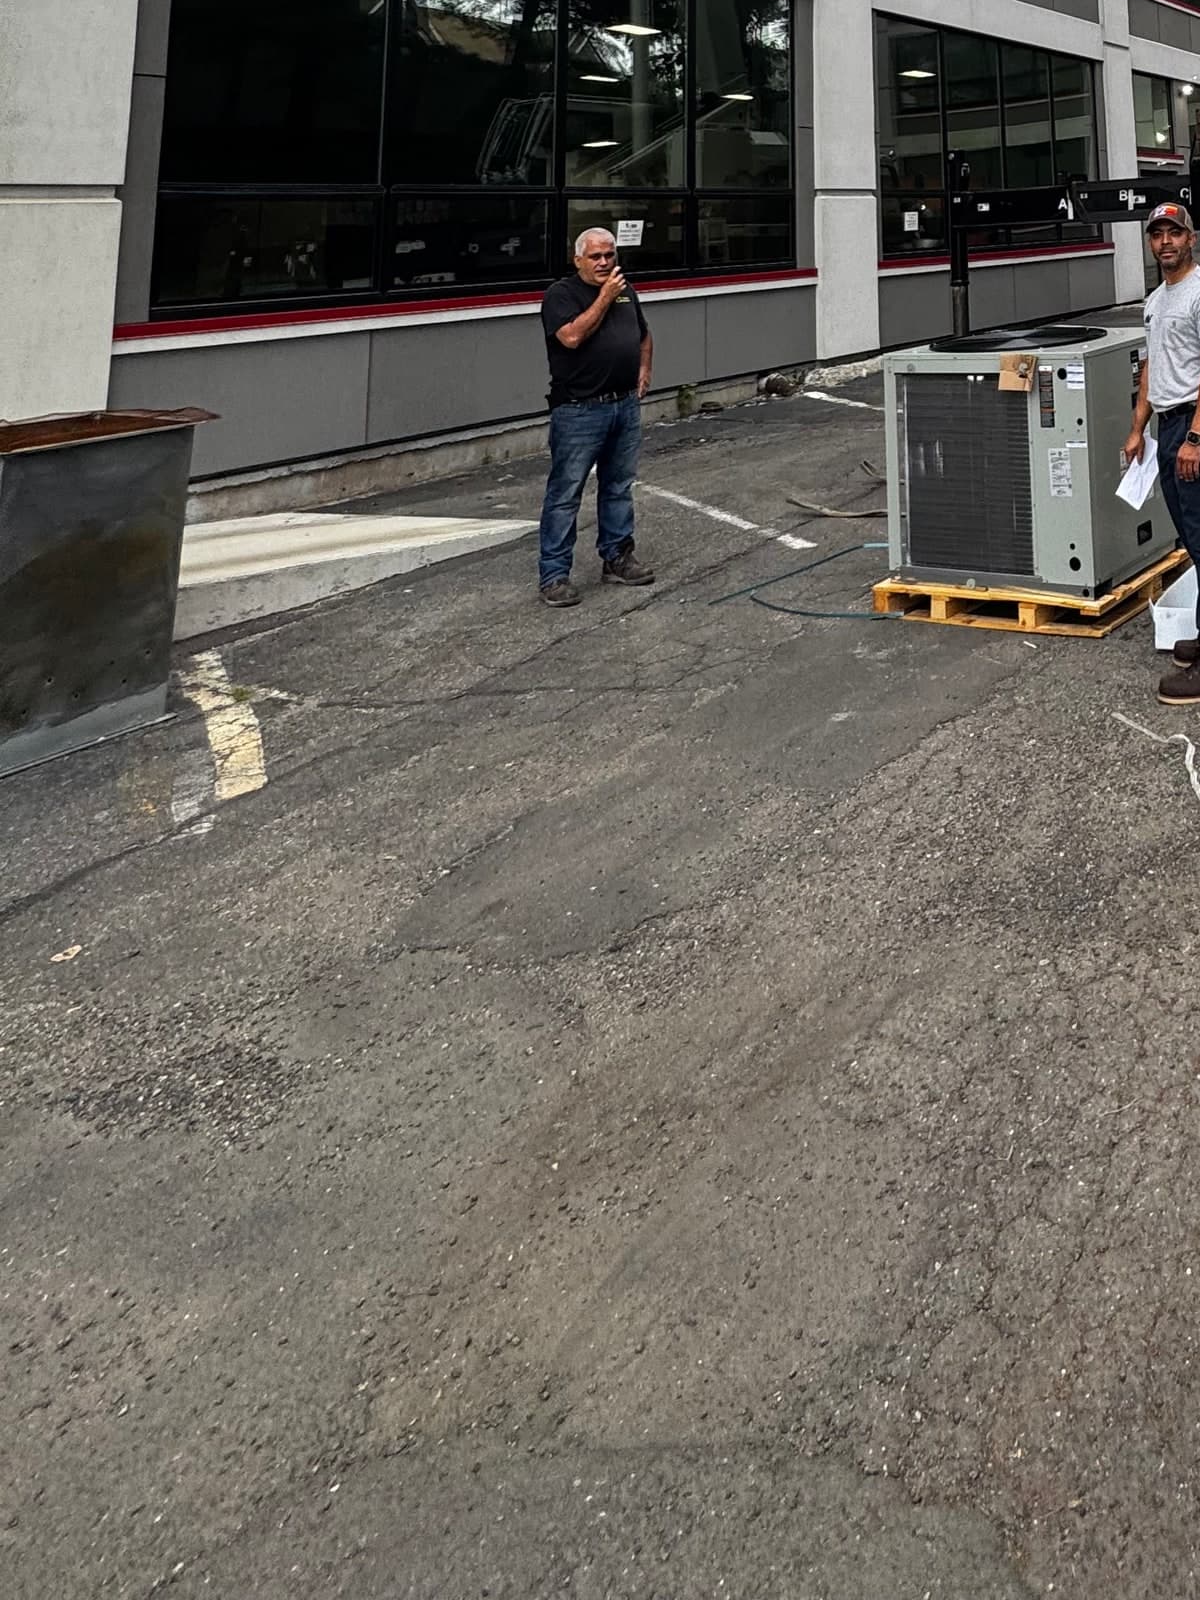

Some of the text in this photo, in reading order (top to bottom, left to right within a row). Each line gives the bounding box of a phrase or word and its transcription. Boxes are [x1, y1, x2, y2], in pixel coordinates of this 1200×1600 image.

[1119, 190, 1128, 201] B
[1180, 187, 1189, 199] C
[1058, 198, 1068, 210] A
